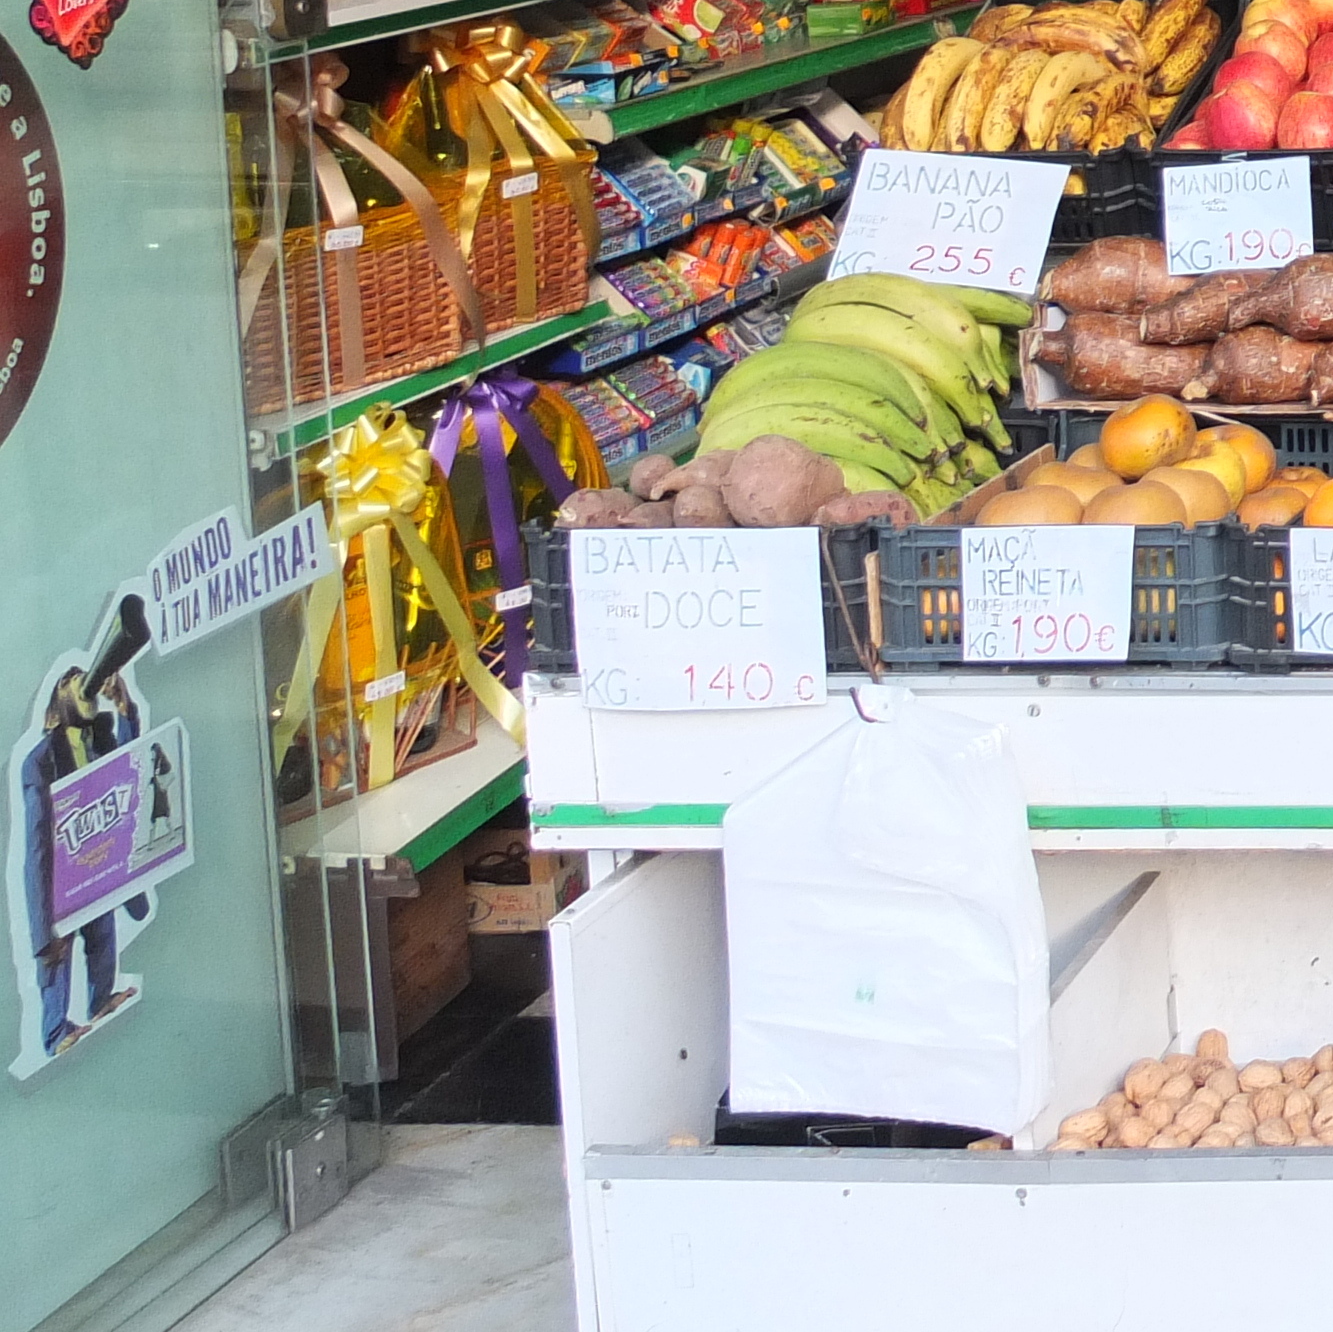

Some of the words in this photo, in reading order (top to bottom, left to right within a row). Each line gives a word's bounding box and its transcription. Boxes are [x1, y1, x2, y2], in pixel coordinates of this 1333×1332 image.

[867, 162, 1012, 198] BANANA
[1170, 168, 1290, 196] MANDIOCA
[931, 198, 1004, 233] PÃO
[909, 245, 993, 275] 2,55
[1225, 228, 1294, 265] 1,90
[165, 517, 231, 594] MUNDO
[584, 536, 740, 573] BATATA
[967, 529, 1036, 569] MAÇÃ
[172, 588, 201, 637] TUA
[208, 517, 317, 620] MANEIRA!
[982, 568, 1084, 596] REINETA
[645, 589, 763, 629] DOCE
[1011, 612, 1092, 658] 1,90
[1094, 625, 1115, 652] €
[684, 662, 774, 706] 1,40
[58, 784, 133, 855] TWIST
